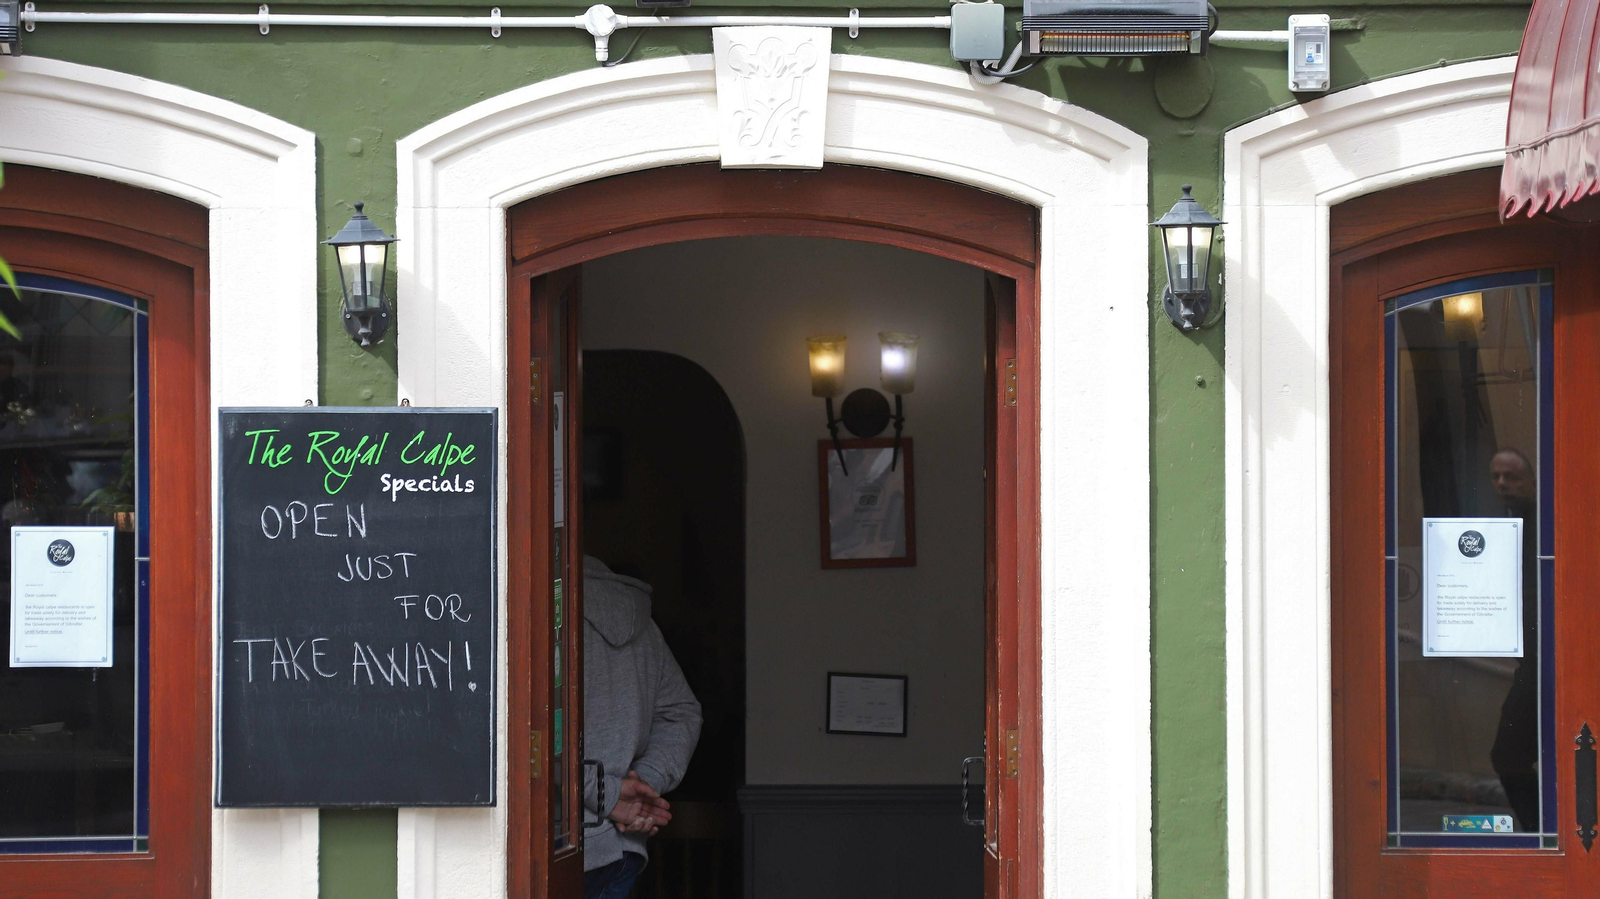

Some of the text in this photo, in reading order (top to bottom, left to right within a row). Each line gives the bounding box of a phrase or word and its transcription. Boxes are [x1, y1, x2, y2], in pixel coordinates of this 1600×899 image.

[245, 429, 476, 494] The Royal Calpe
[380, 473, 474, 502] Specials
[261, 500, 366, 539] OPEN
[338, 552, 417, 581] JUST
[394, 593, 471, 622] FOR
[233, 637, 476, 692] TAKE AWAY!
